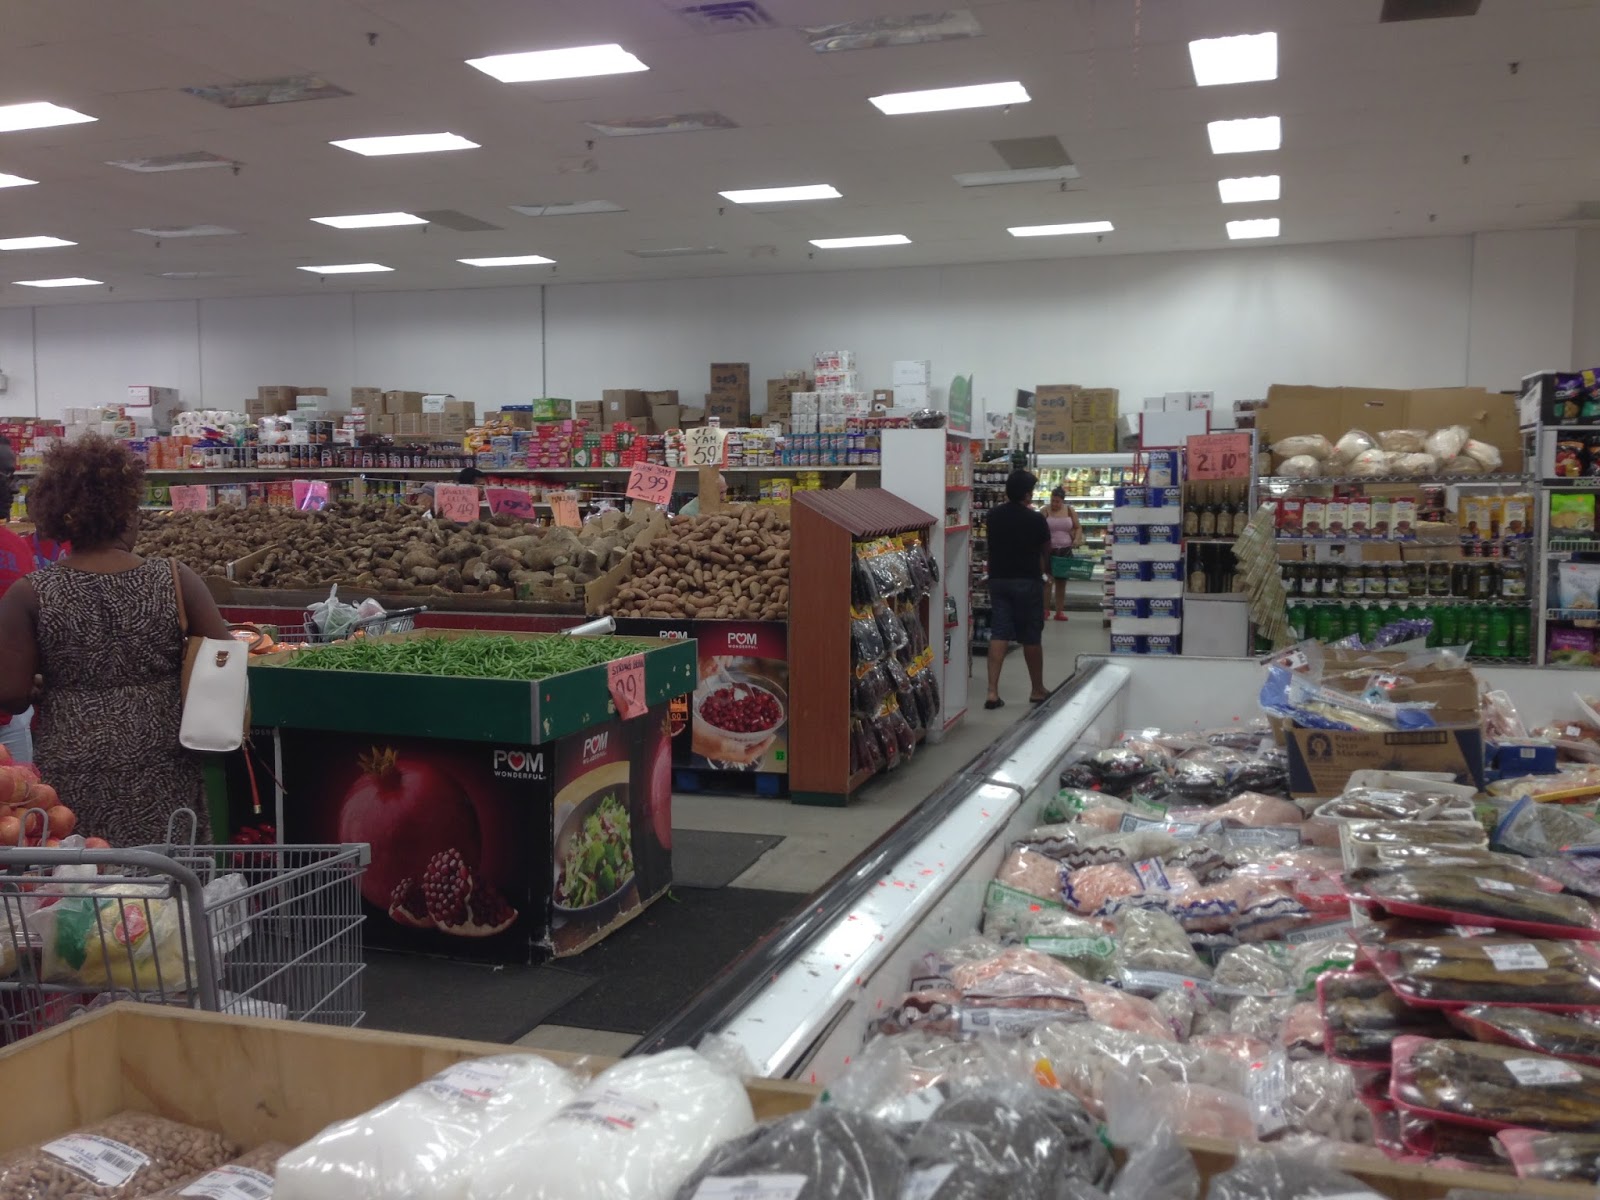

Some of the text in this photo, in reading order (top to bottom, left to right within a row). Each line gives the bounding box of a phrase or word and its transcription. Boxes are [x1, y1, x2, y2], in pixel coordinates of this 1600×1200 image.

[692, 435, 717, 445] YAM
[1197, 453, 1209, 471] 2
[1221, 453, 1237, 471] 10
[1115, 526, 1138, 534] GOYA
[1149, 526, 1170, 534] GOYA
[1117, 562, 1139, 570] GOYA
[1152, 562, 1175, 570] GOYA
[1114, 599, 1136, 607] GOYA
[1150, 599, 1173, 607] GOYA
[727, 632, 757, 645] POM
[1112, 636, 1135, 644] GOYA
[1147, 636, 1171, 644] GOYA
[583, 731, 609, 758] POM
[493, 750, 544, 773] POM
[494, 769, 546, 780] WONDERFUL
